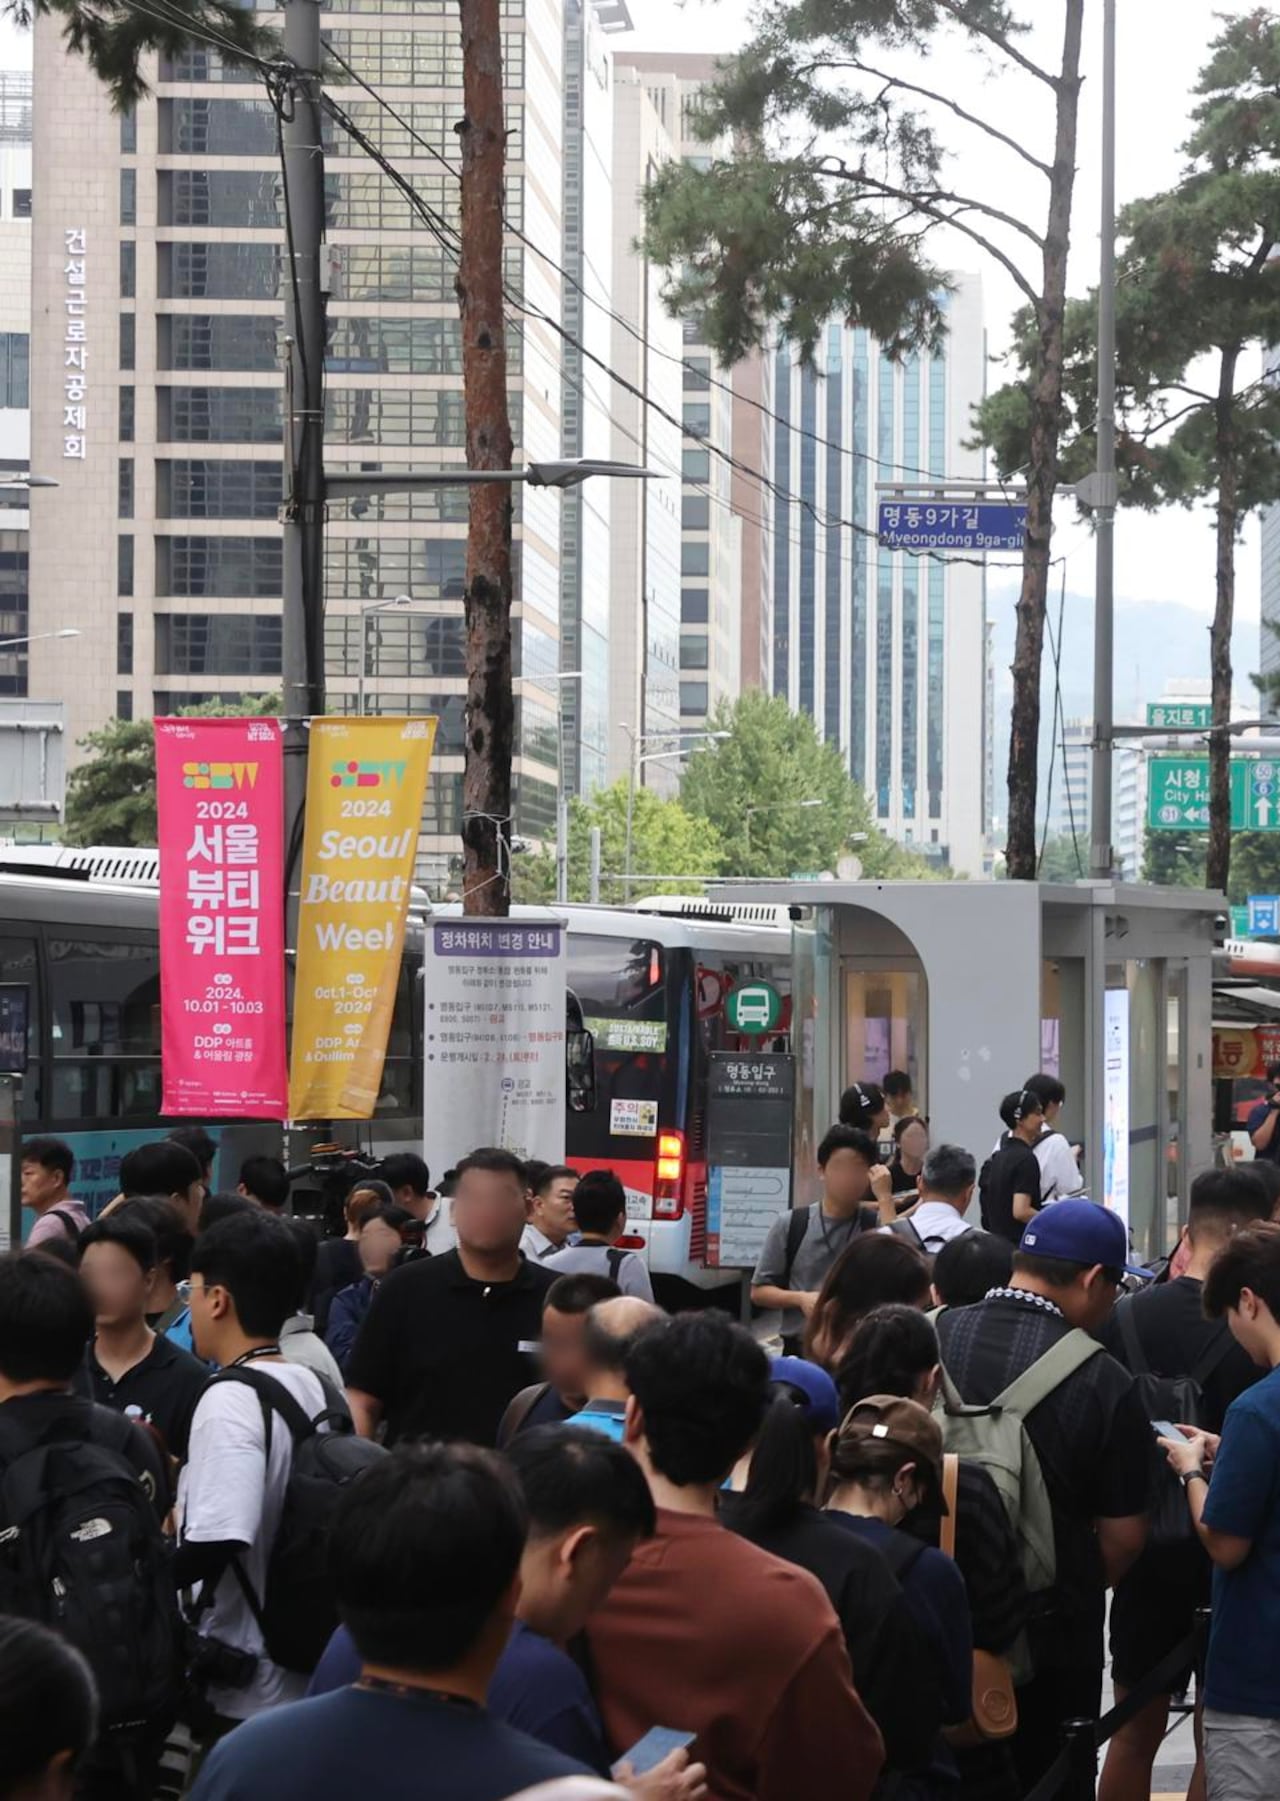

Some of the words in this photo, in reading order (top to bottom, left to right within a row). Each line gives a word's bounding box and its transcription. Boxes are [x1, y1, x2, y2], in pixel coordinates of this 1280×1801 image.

[64, 229, 88, 459] 건설근로자공제회
[883, 506, 979, 529] 명동9가길
[882, 531, 972, 549] Myeongdong
[1165, 769, 1201, 788] 시청
[1164, 790, 1190, 804] City
[196, 802, 248, 818] 2024
[341, 800, 391, 817] 2024
[186, 824, 258, 864] 서울
[318, 828, 413, 859] Seoul
[187, 870, 259, 909] 뷰티
[186, 915, 260, 956] 위크
[441, 931, 492, 949] 정차위치
[498, 932, 523, 950] 변경
[527, 932, 554, 950] 안내
[206, 987, 244, 999] 2024.
[184, 1000, 219, 1013] 10.01
[230, 1002, 263, 1014] 10.03
[334, 1001, 372, 1014] 2024
[194, 1036, 223, 1048] DDP
[316, 1037, 342, 1048] DDP
[727, 1064, 776, 1080] 명동입구
[614, 1102, 639, 1114] 주의
